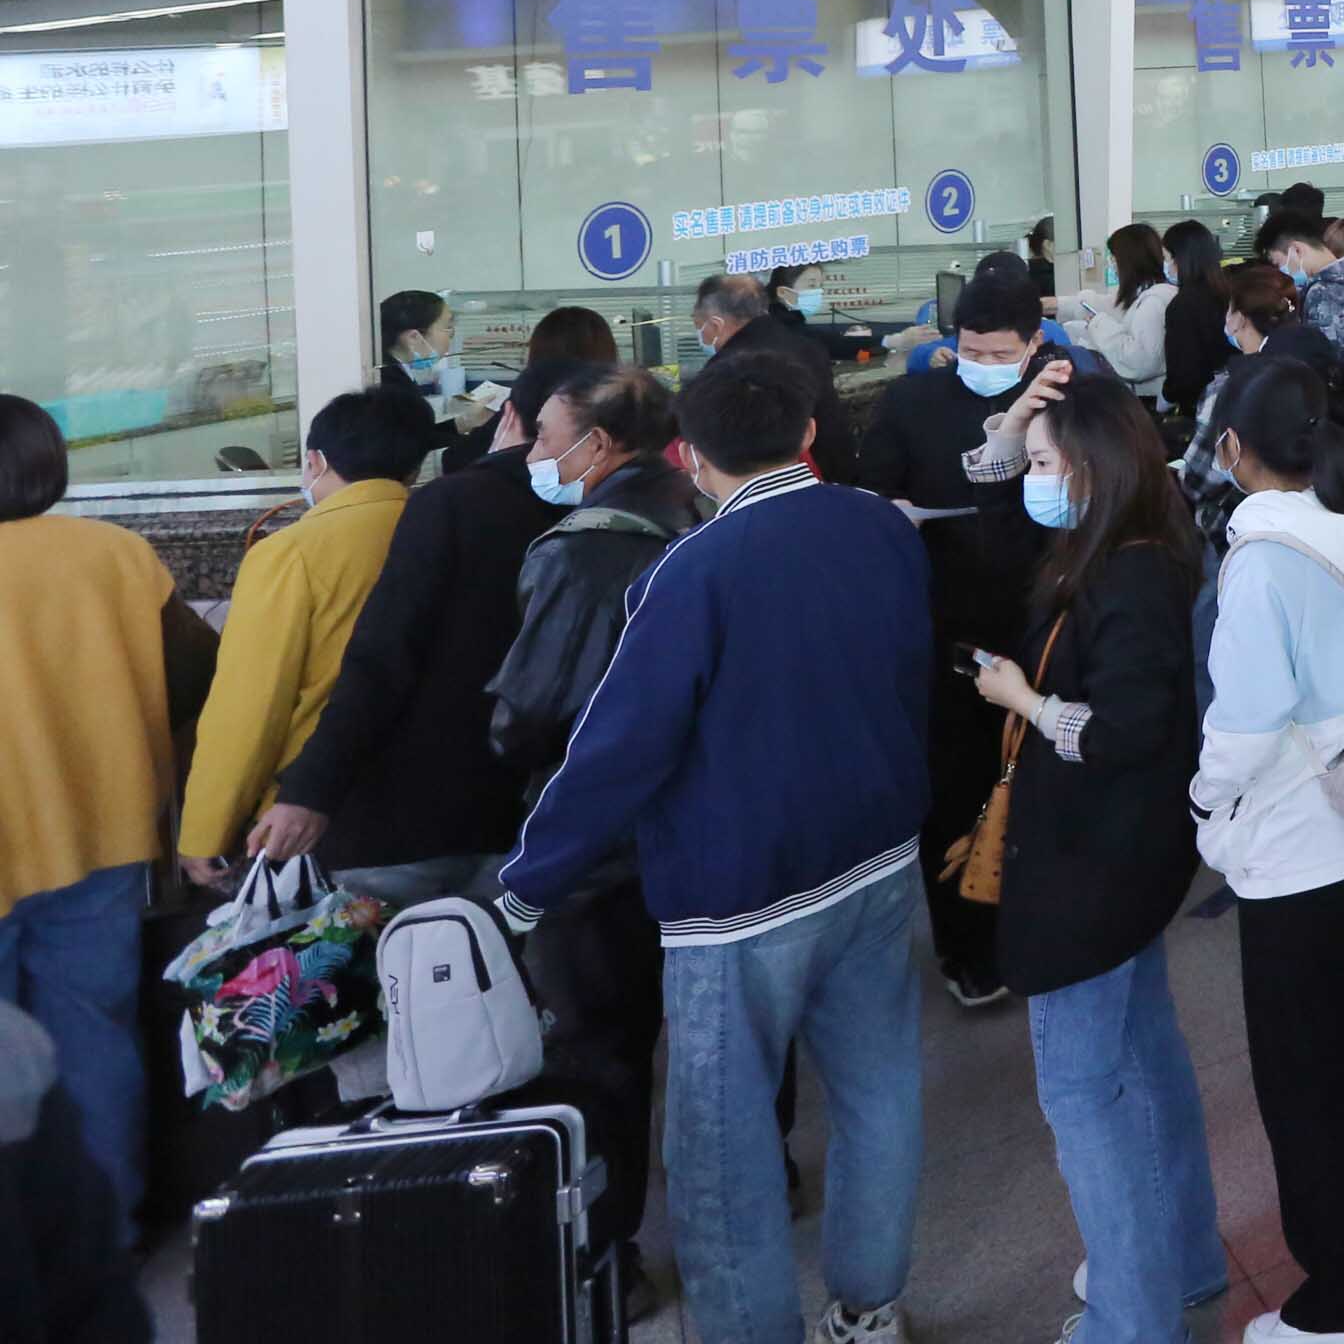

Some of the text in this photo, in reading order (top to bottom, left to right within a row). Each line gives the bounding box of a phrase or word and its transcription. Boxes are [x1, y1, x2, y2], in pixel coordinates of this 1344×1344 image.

[1213, 157, 1229, 184] 3
[942, 186, 960, 216] 2
[673, 207, 736, 240] 实名售票
[604, 223, 622, 259] 1
[727, 235, 870, 275] 消防员优先购票
